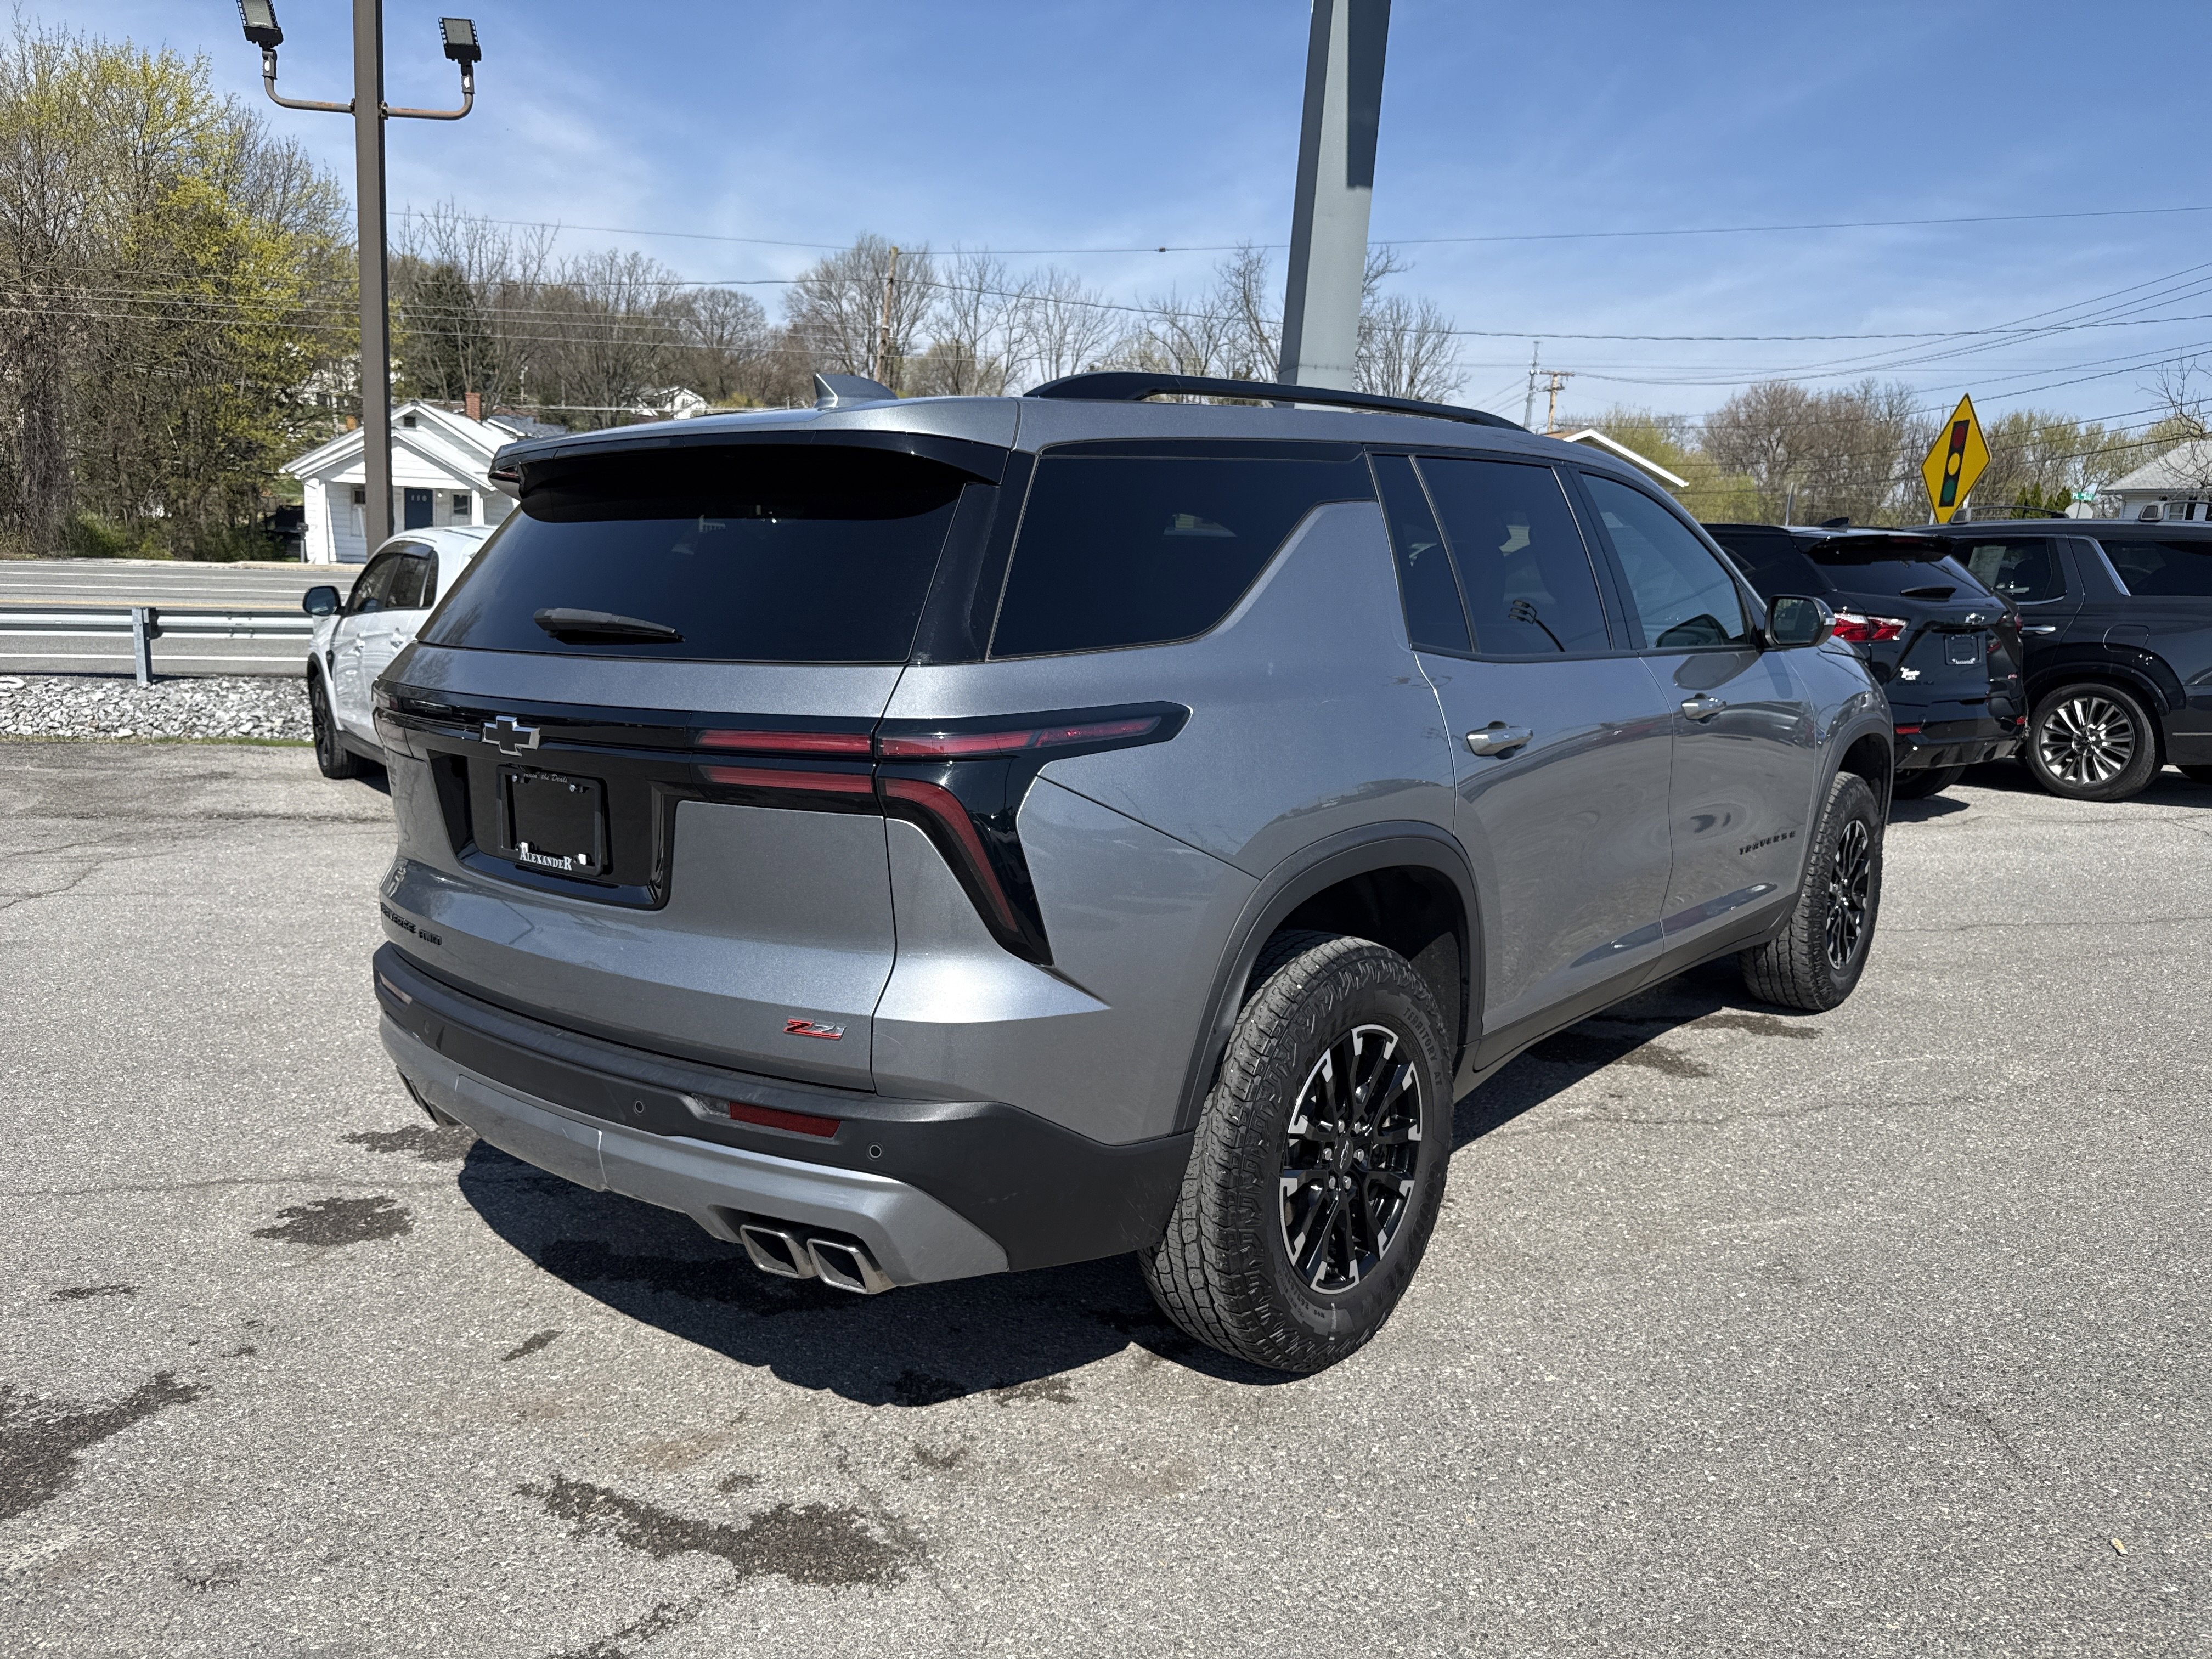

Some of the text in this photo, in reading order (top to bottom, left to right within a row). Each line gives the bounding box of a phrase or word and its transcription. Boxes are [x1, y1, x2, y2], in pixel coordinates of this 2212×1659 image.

[551, 774, 568, 783] Deals
[1739, 830, 1796, 855] TRAVERSE
[520, 848, 572, 871] ALEXANDER
[783, 1018, 847, 1041] Z71
[1403, 1007, 1442, 1086] TERRITORY AT
